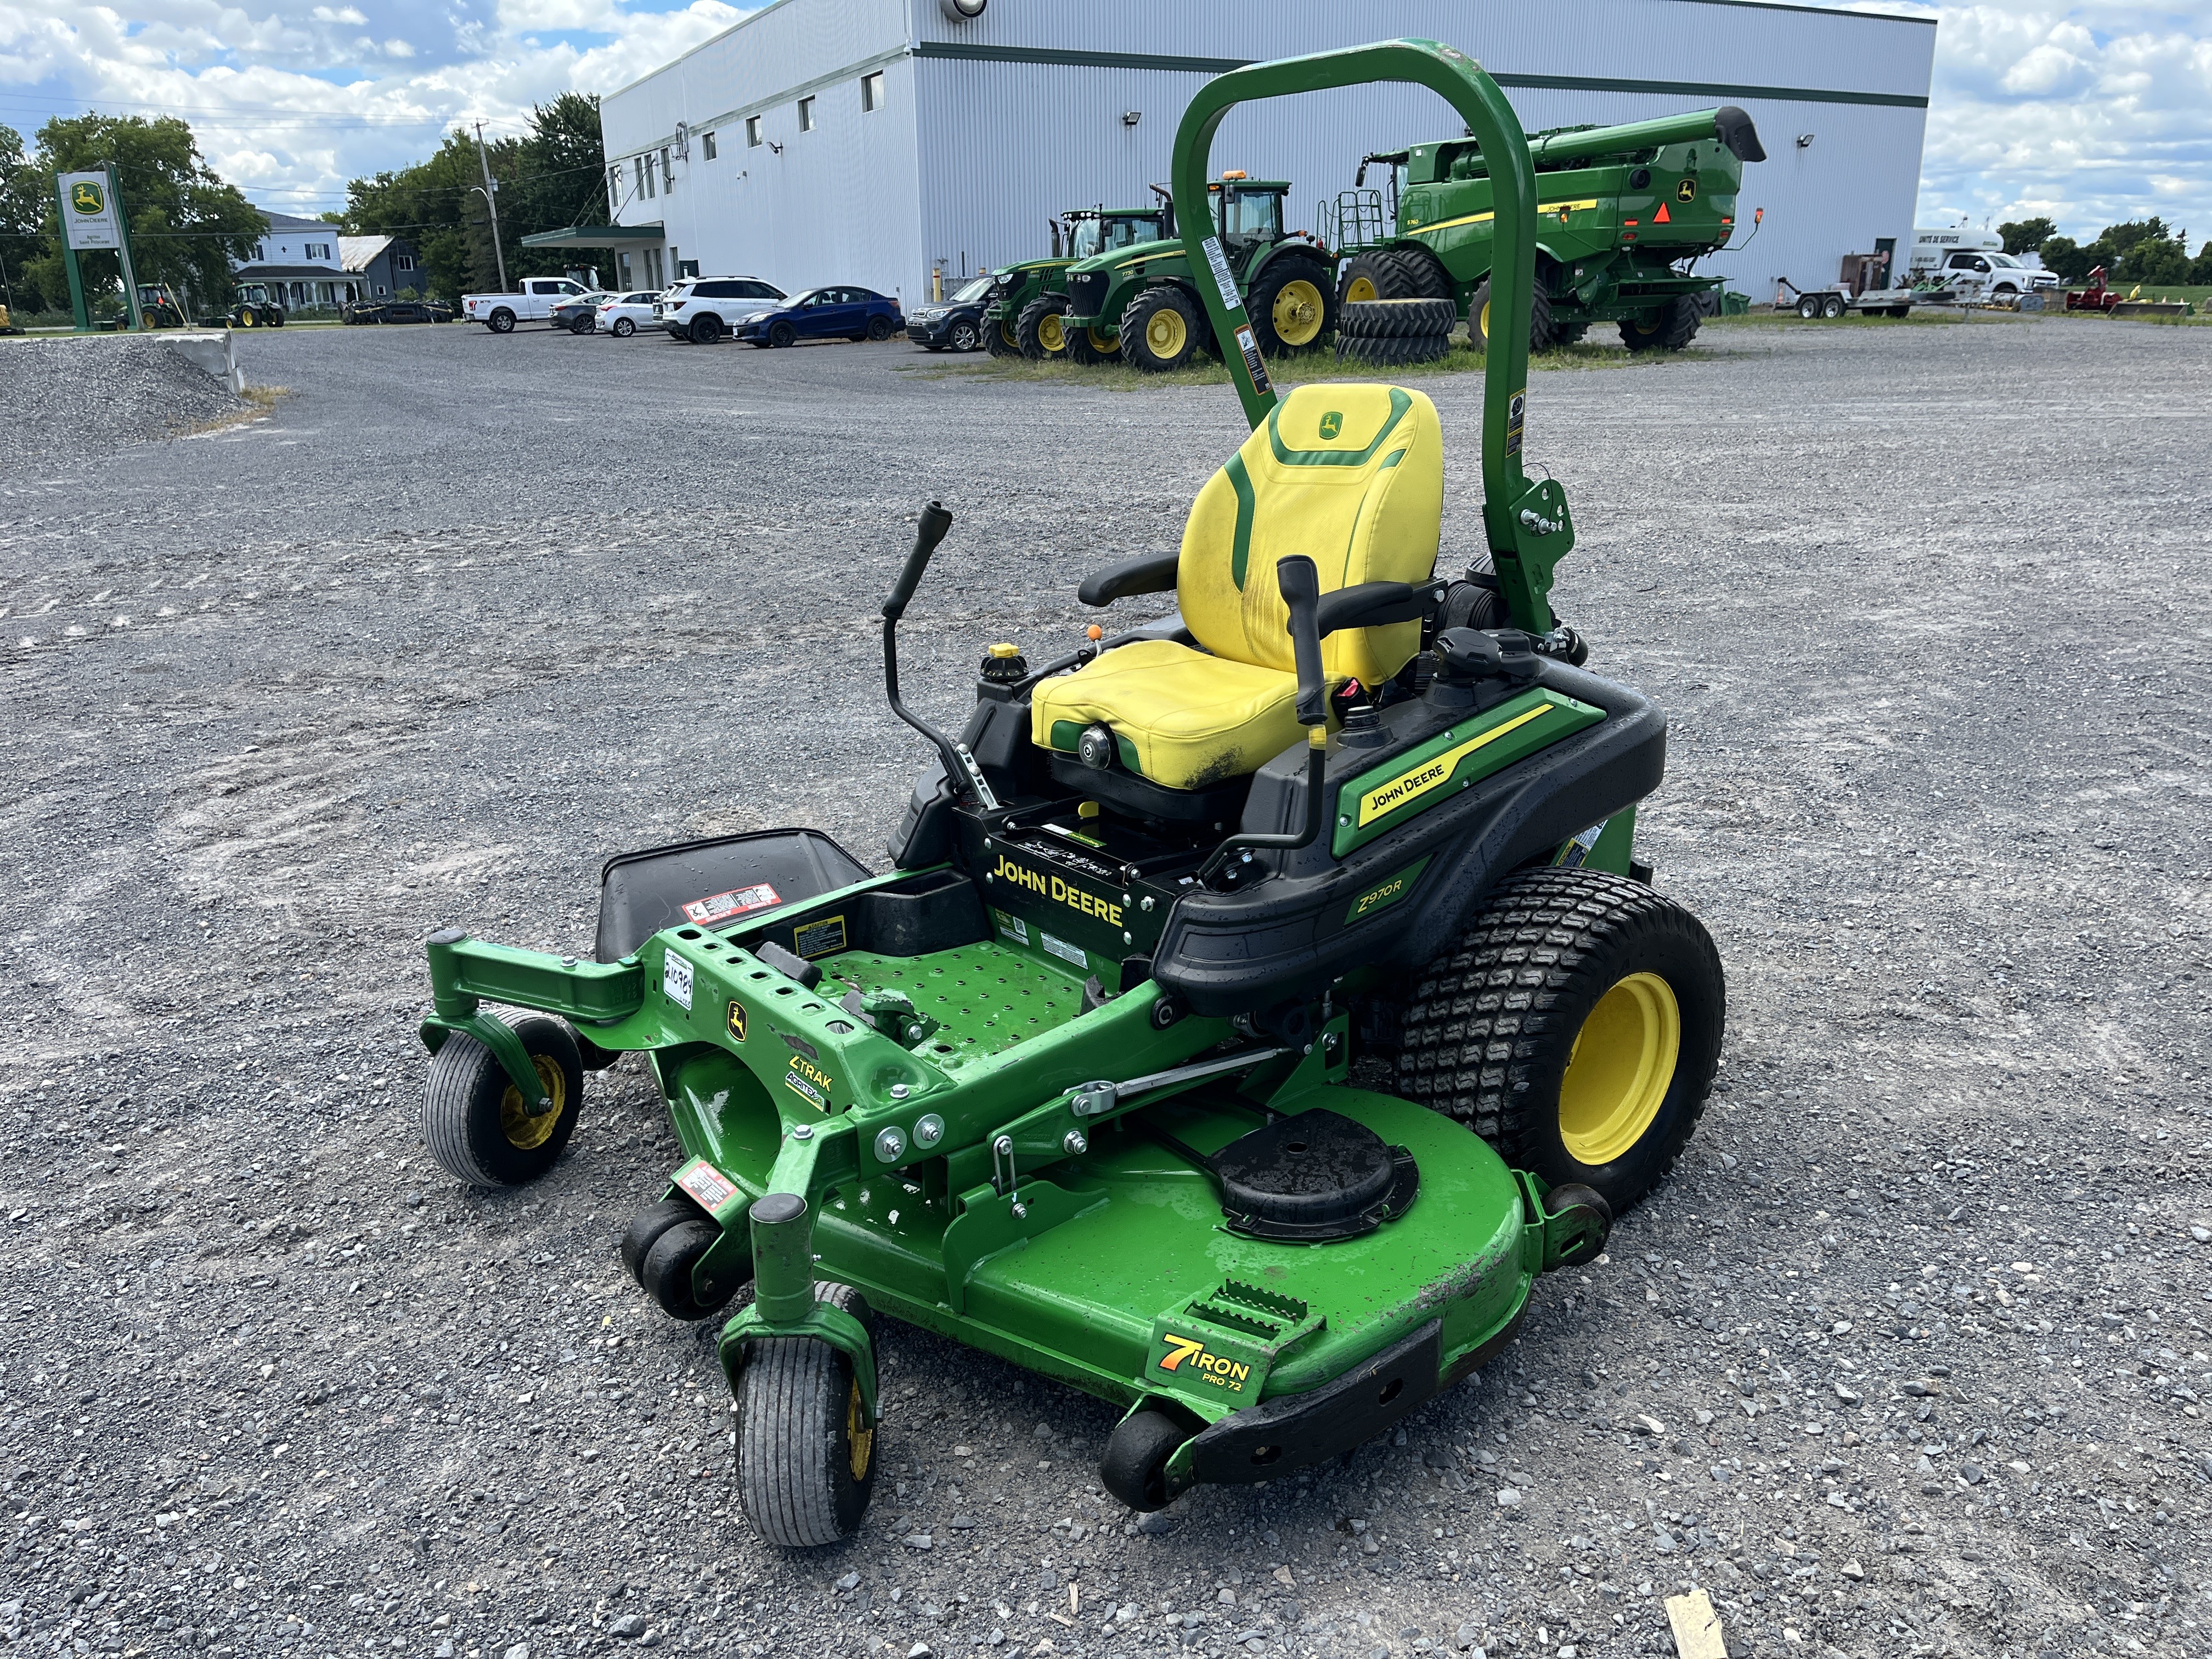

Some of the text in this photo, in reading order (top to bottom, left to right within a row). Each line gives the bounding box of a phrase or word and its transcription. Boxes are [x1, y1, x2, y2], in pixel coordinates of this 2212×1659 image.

[1939, 235, 1960, 244] SERVICE
[1372, 764, 1444, 811] JOHN DEERE
[994, 854, 1046, 895] JOHN
[1051, 875, 1123, 928] DEERE
[1357, 879, 1402, 913] Z970R
[786, 1073, 816, 1097] AGRITEX
[1201, 1373, 1243, 1392] PRO 72
